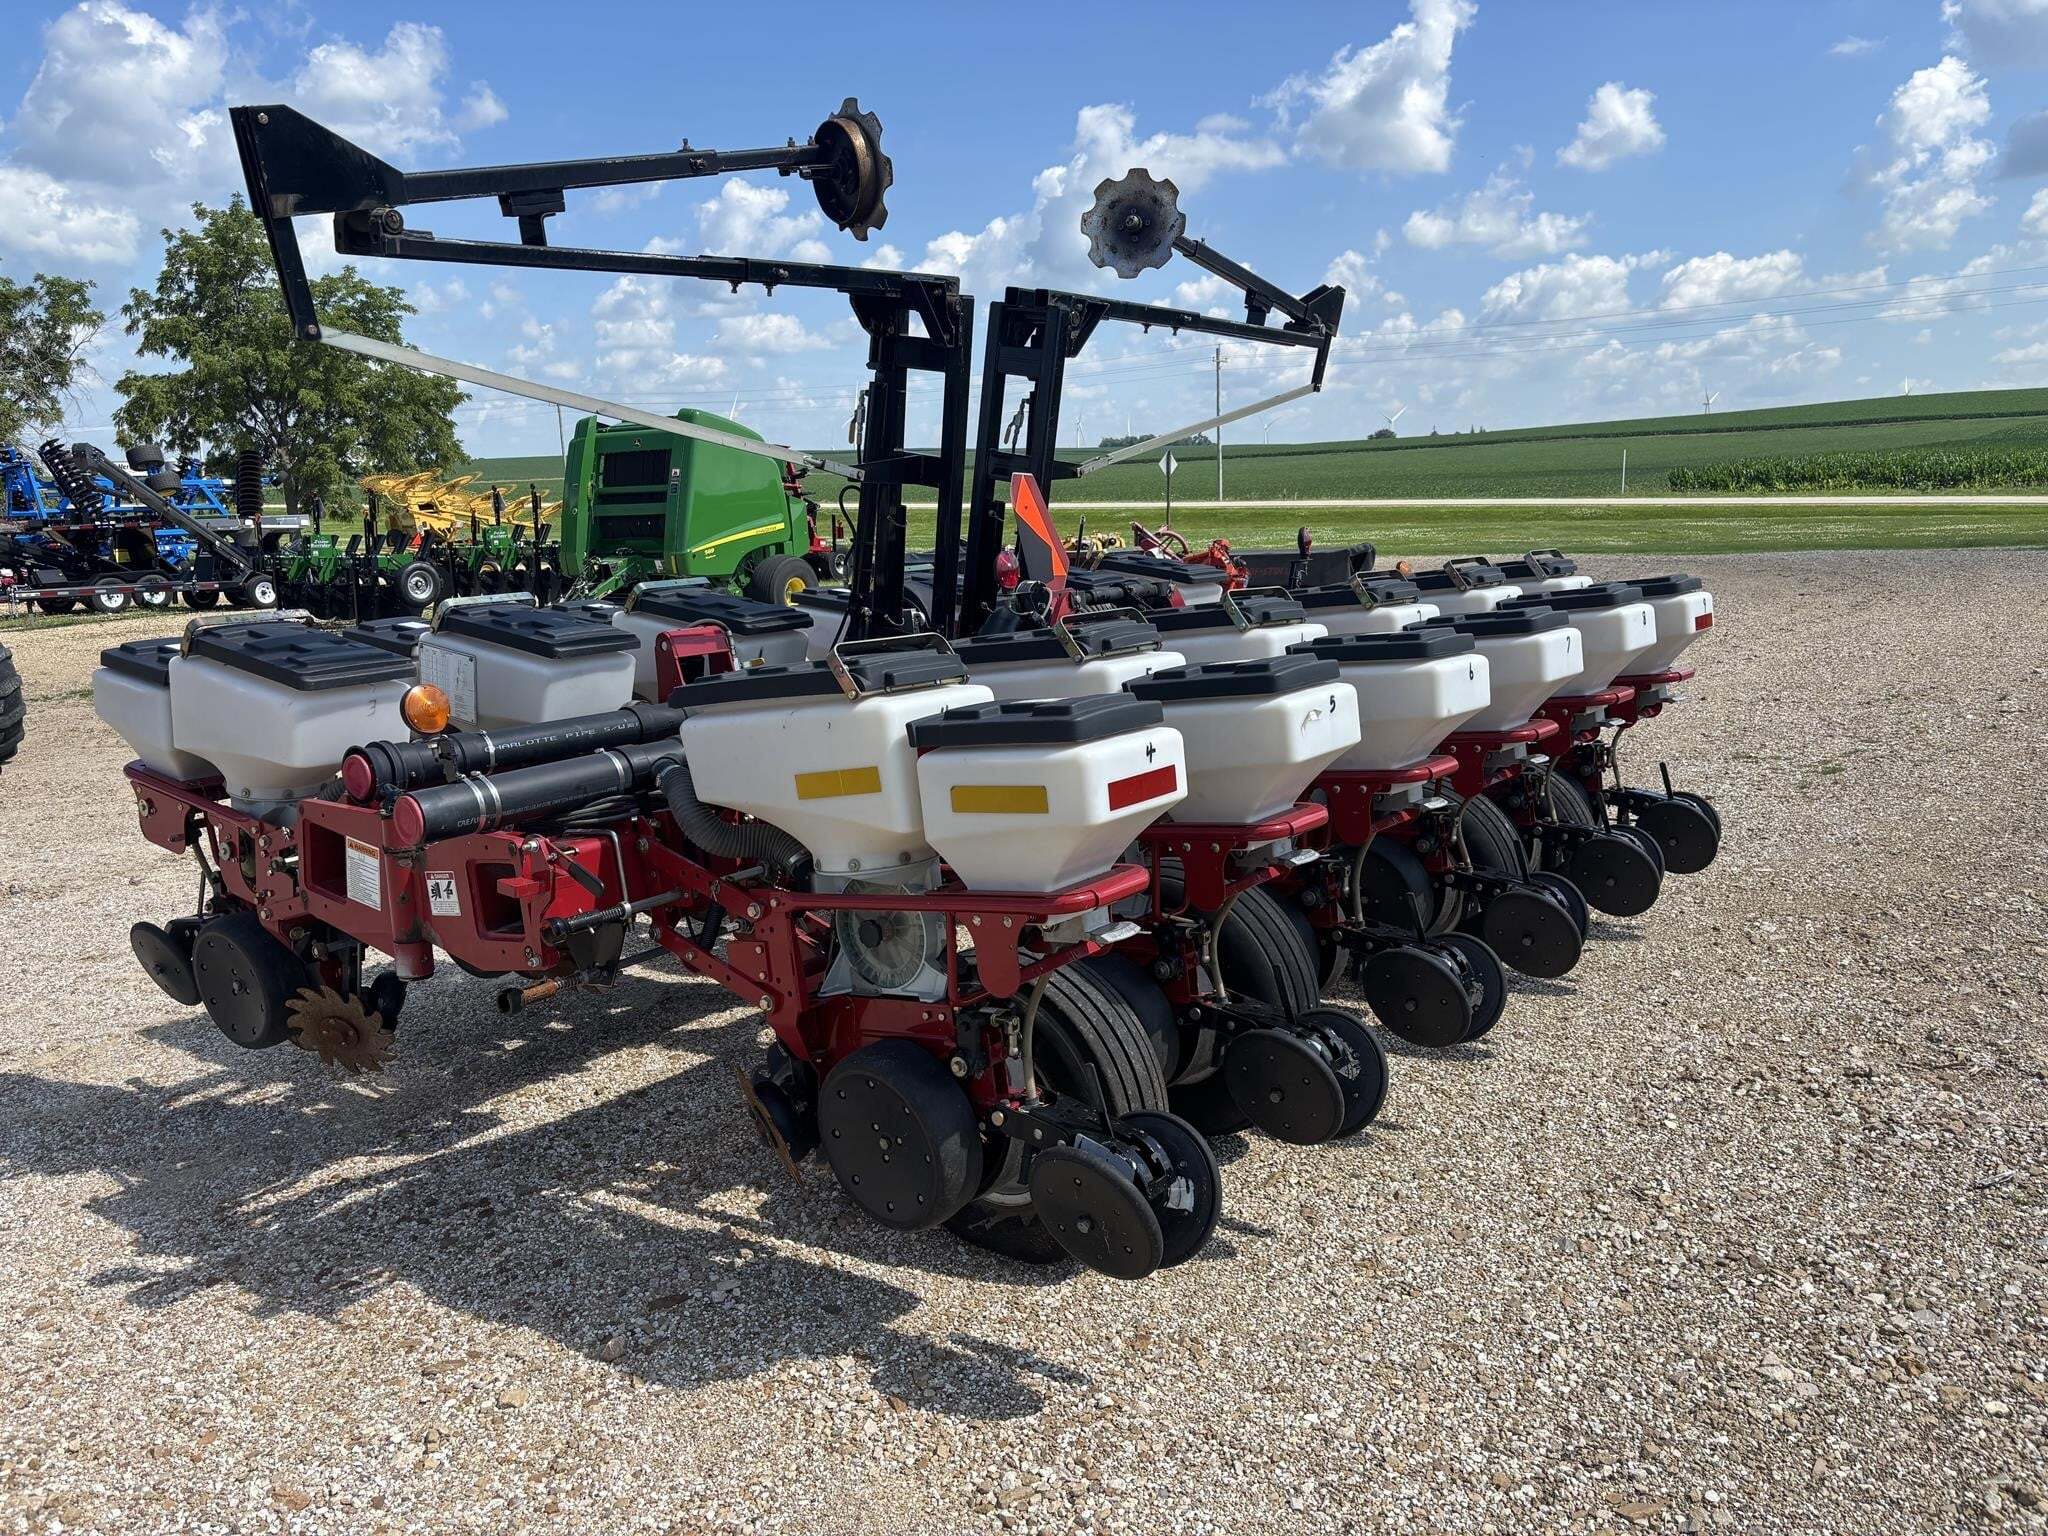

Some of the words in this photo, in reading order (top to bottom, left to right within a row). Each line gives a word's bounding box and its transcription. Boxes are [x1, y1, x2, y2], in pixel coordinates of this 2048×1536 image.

[1641, 610, 1647, 626] 8
[1565, 636, 1571, 654] 7
[1468, 663, 1474, 681] 6
[1329, 694, 1337, 713] 5
[484, 734, 558, 753] CHARLOTTE
[565, 729, 596, 739] PIPE
[1146, 741, 1157, 763] 4
